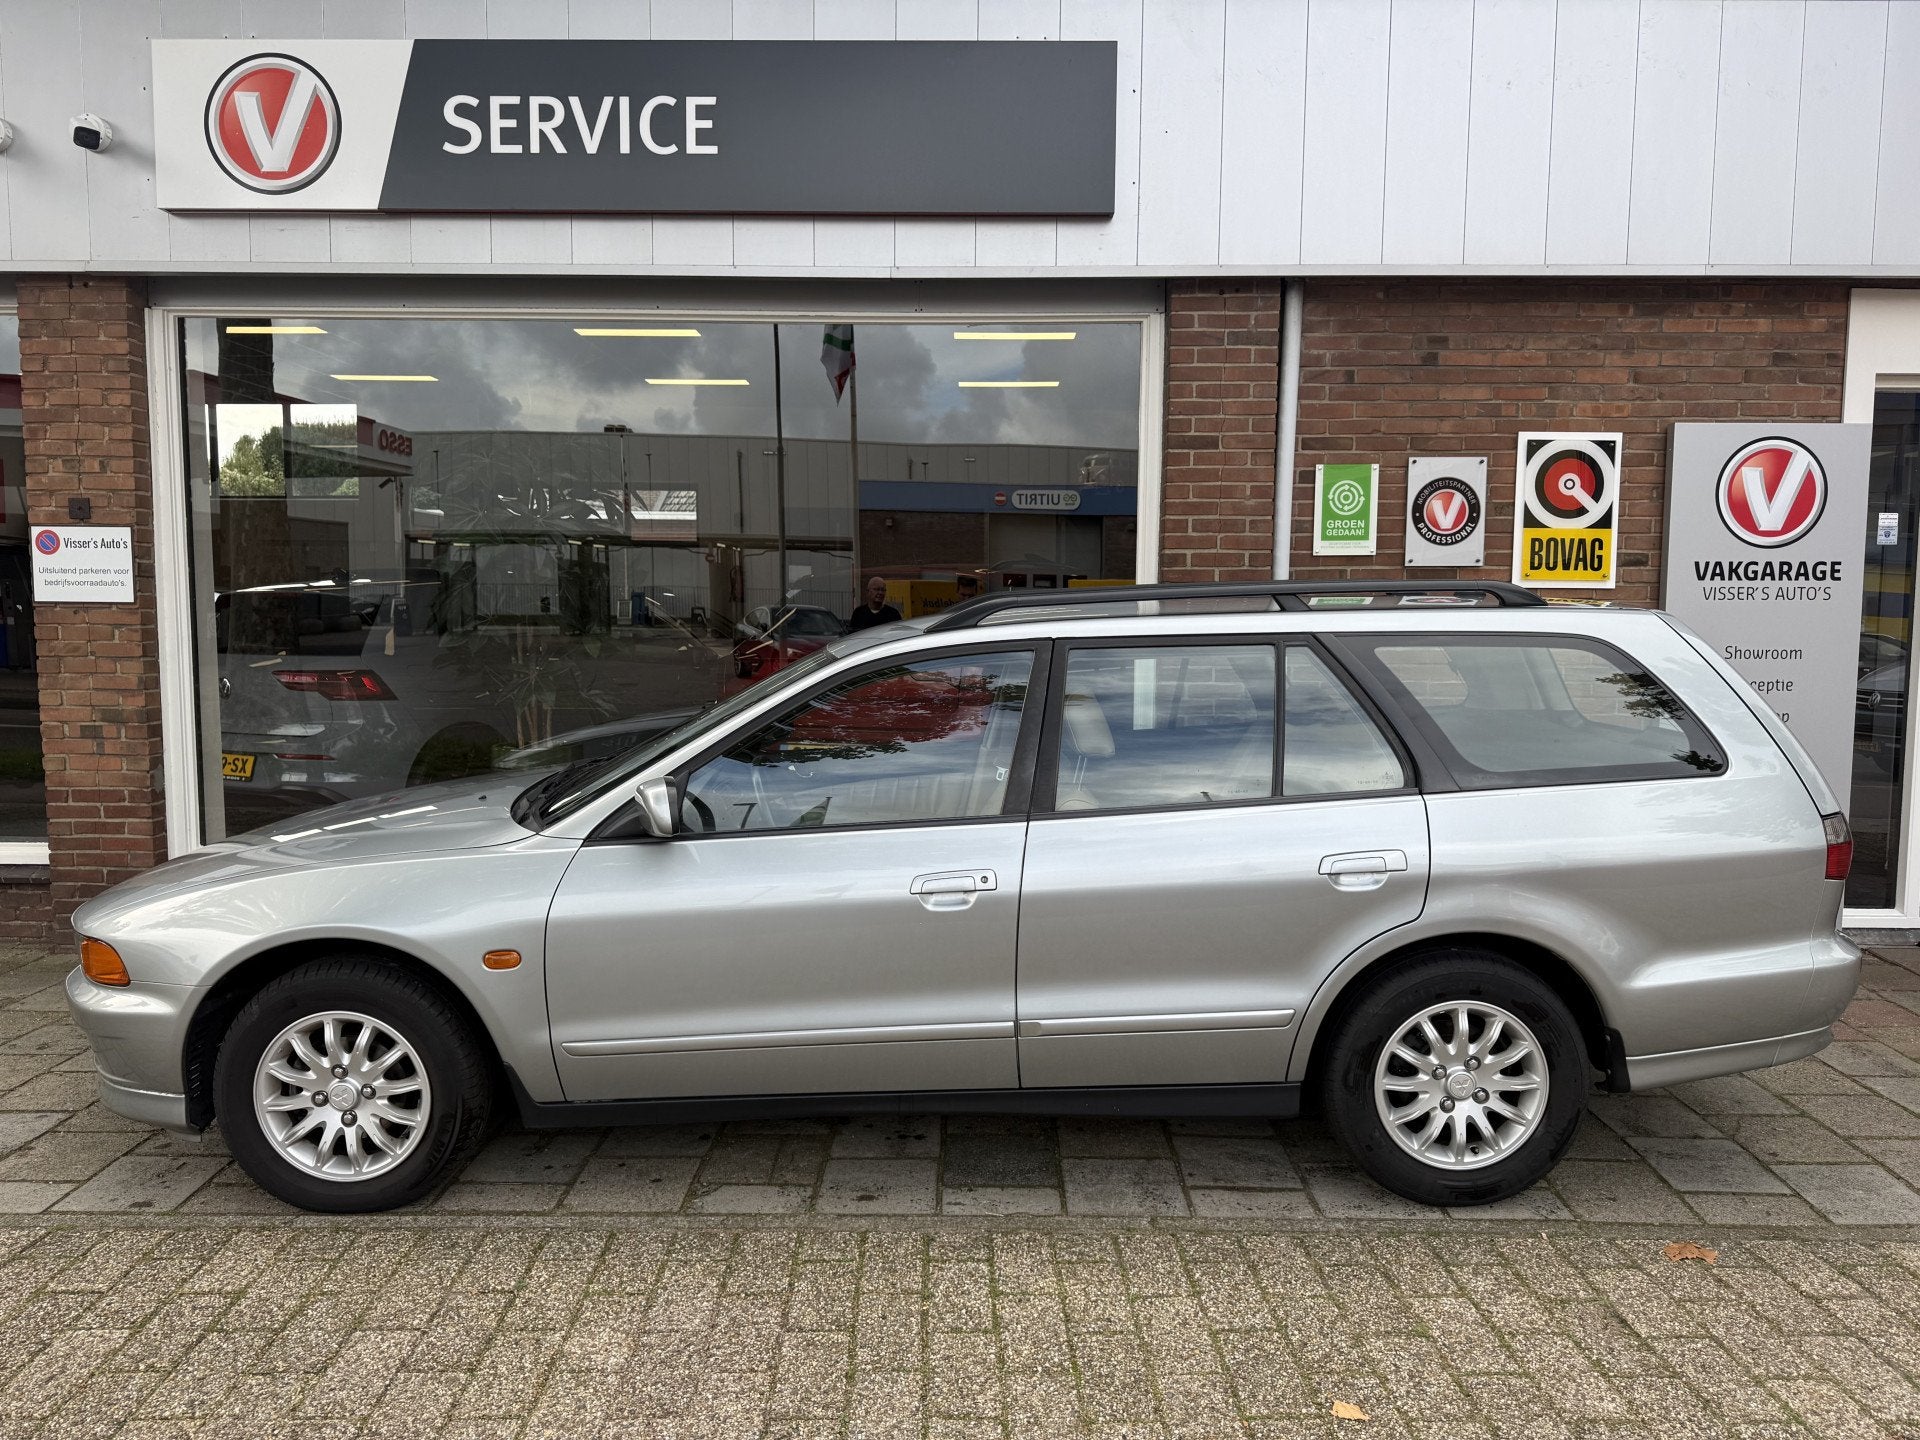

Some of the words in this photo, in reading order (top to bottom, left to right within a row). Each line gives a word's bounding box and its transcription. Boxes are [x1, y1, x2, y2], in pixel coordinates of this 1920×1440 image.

[442, 94, 719, 155] SERVICE
[1417, 479, 1477, 505] MOBILITEITSPARTNER
[1326, 519, 1365, 529] GROEN
[1417, 522, 1476, 544] PROFESSIONAL
[63, 537, 99, 549] Visser's
[100, 537, 128, 549] Auto's
[1529, 537, 1604, 572] BOVAG
[38, 566, 77, 575] Uitsluitend
[78, 567, 112, 576] parkeren
[1694, 561, 1842, 582] VAKGARAGE
[44, 578, 127, 588] bedrijfsvoorraadauto's.
[1702, 586, 1770, 601] VISSER'S
[1775, 586, 1832, 601] AUTO'S
[1724, 645, 1803, 660] Showroom
[1750, 679, 1794, 695] ceptie
